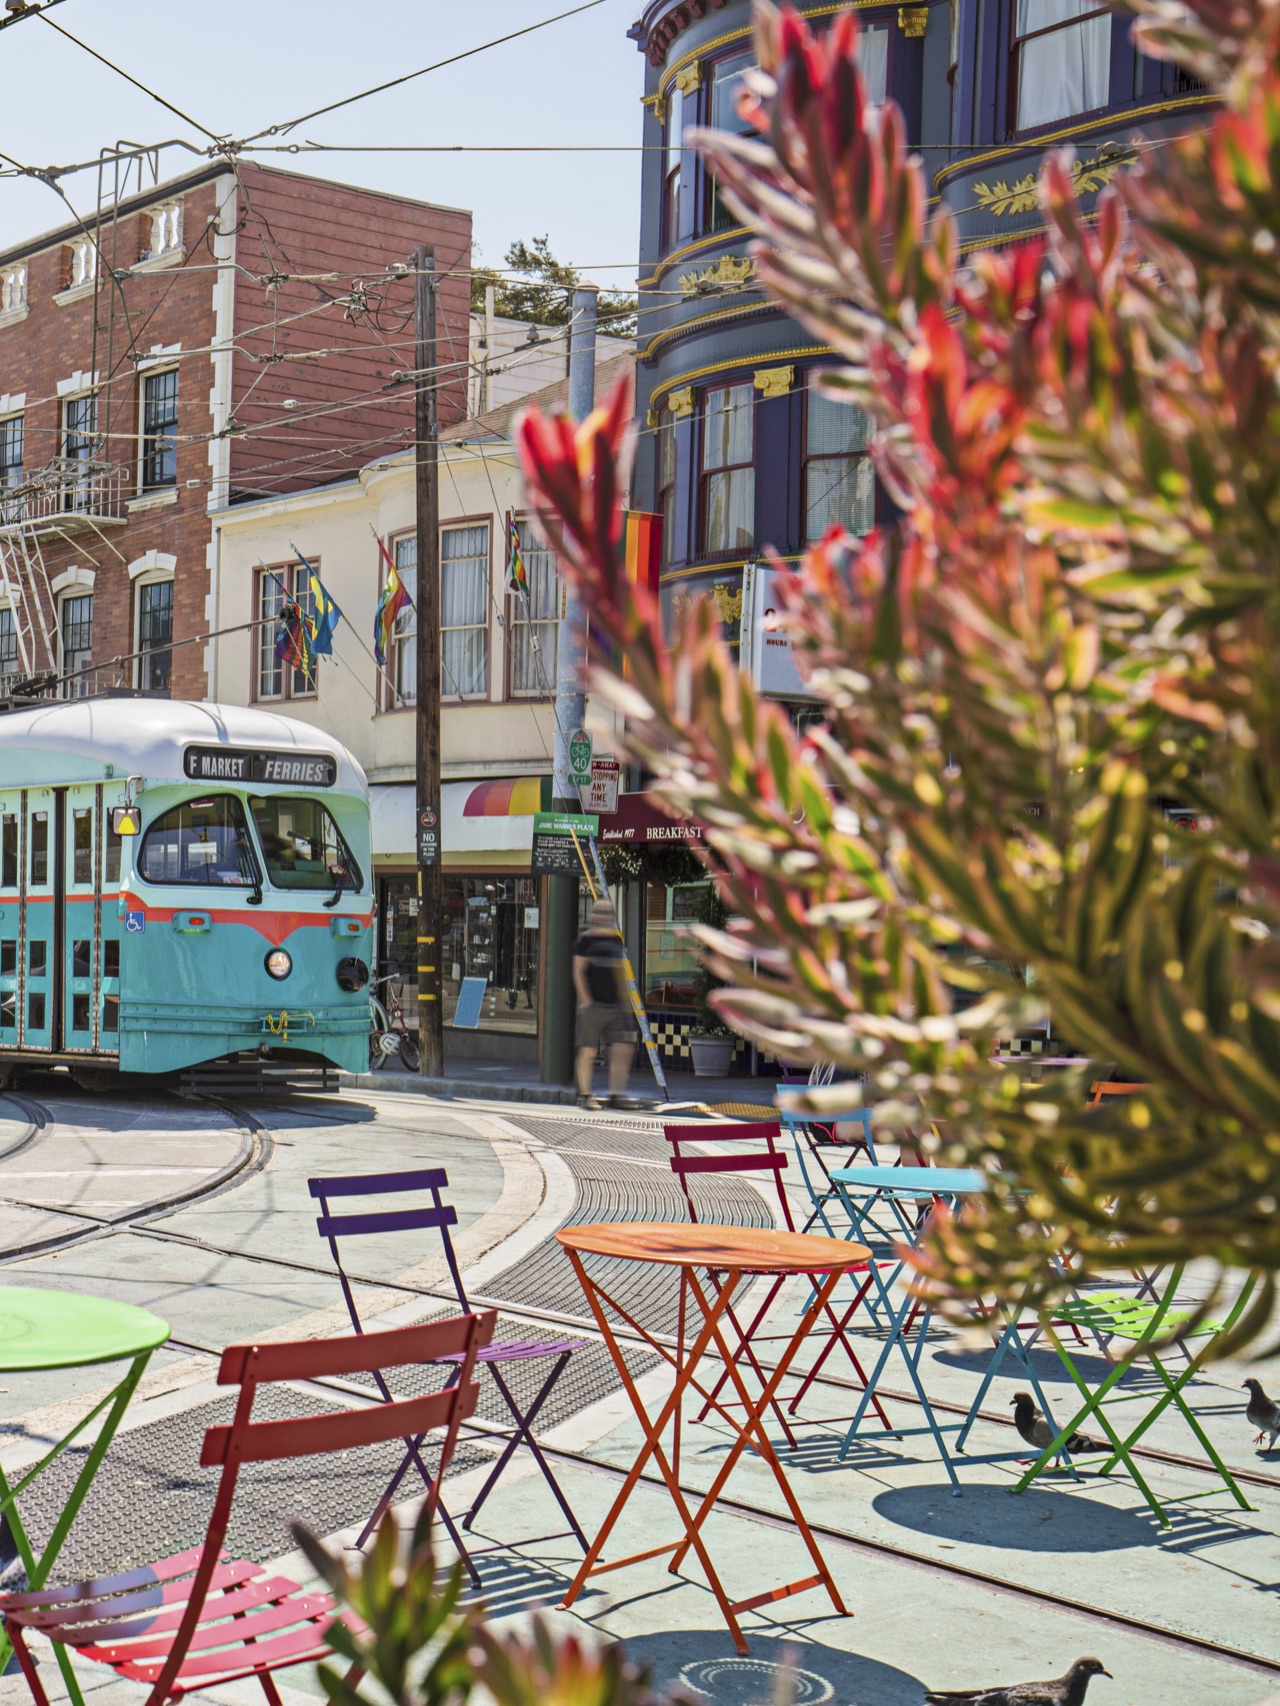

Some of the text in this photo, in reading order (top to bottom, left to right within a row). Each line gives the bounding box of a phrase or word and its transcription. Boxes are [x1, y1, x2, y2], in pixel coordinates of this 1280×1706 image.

[766, 639, 787, 647] HOURS
[573, 757, 587, 769] 40
[190, 755, 324, 782] F MARKET FERRIES
[593, 771, 617, 782] STOPPING
[592, 782, 607, 792] ANY
[590, 793, 607, 802] TIME
[423, 832, 435, 842] NO
[646, 826, 703, 839] BREAKFAST
